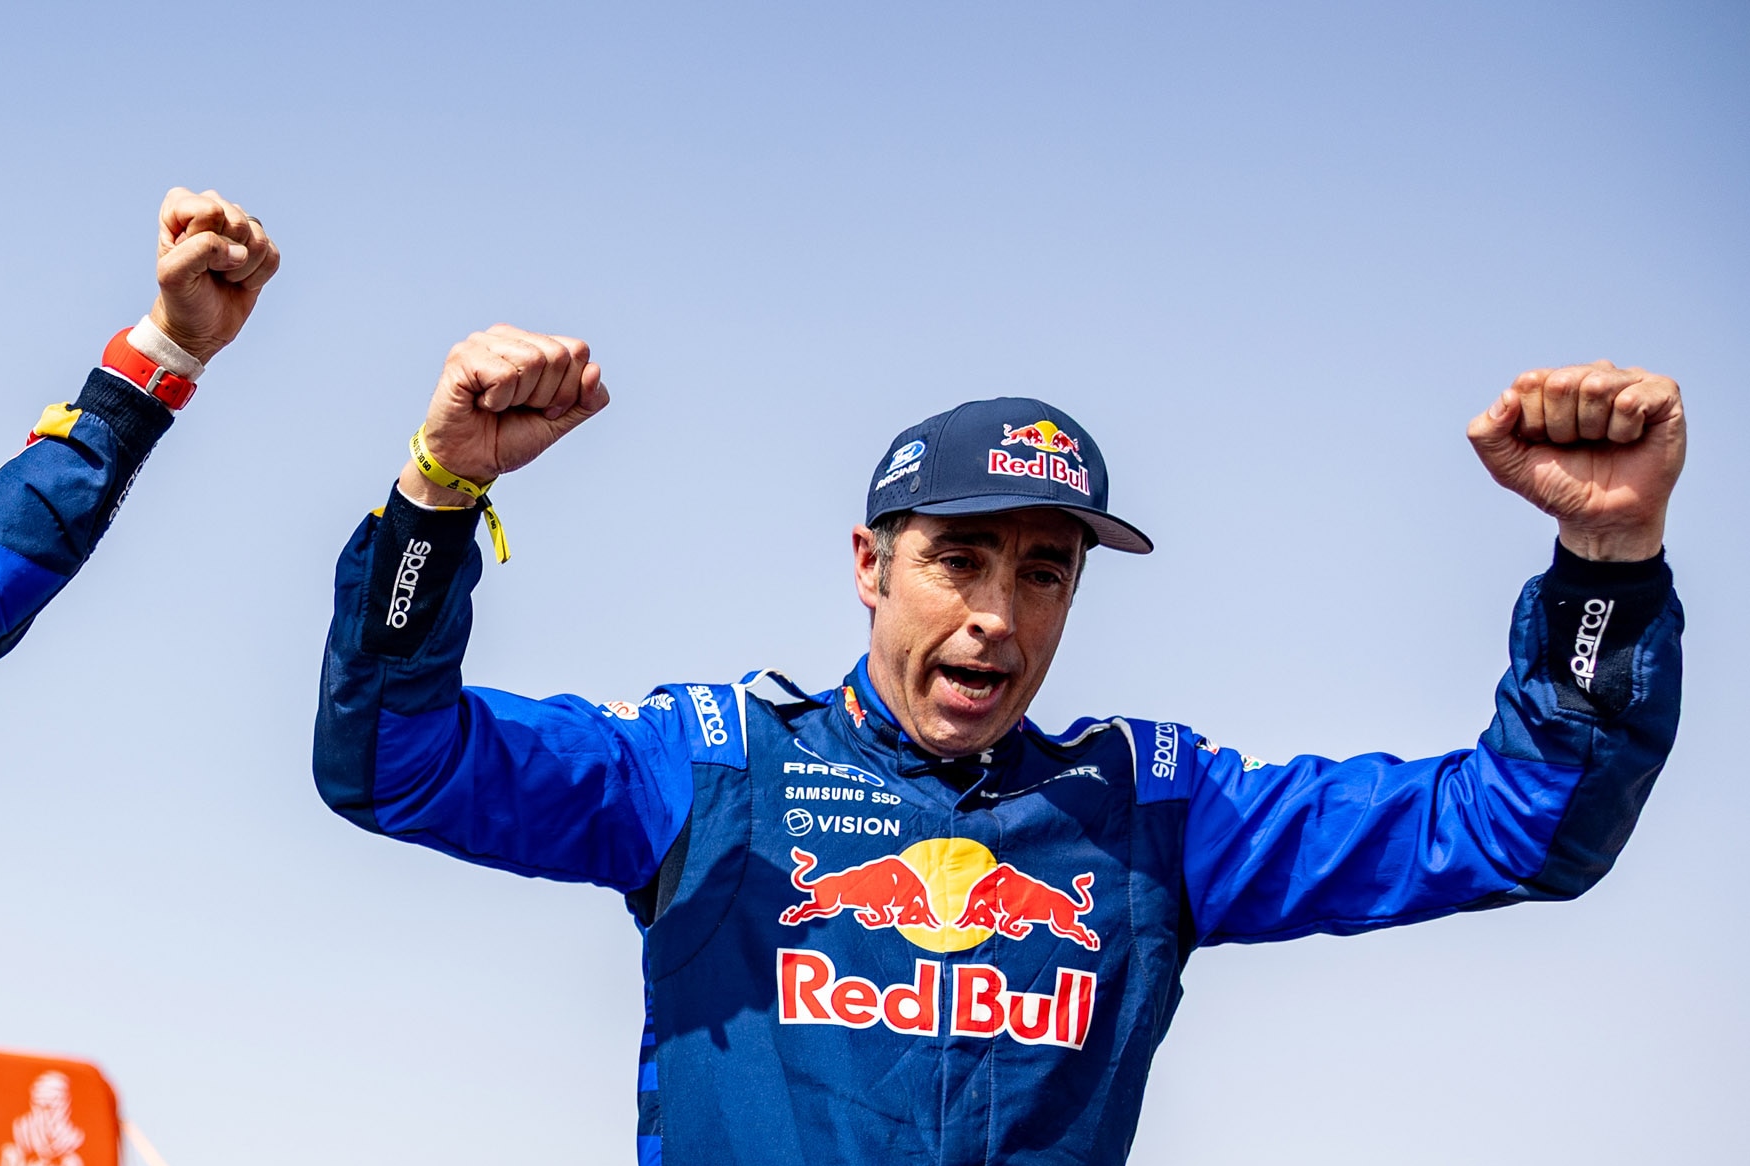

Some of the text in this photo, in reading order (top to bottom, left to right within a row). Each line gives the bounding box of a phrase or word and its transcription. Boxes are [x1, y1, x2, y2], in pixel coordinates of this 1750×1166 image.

[988, 449, 1091, 496] Red Bull
[386, 538, 431, 629] sparco
[785, 786, 902, 806] SAMSUNG SSD
[817, 814, 901, 837] VISION
[777, 948, 1097, 1051] Red Bull
